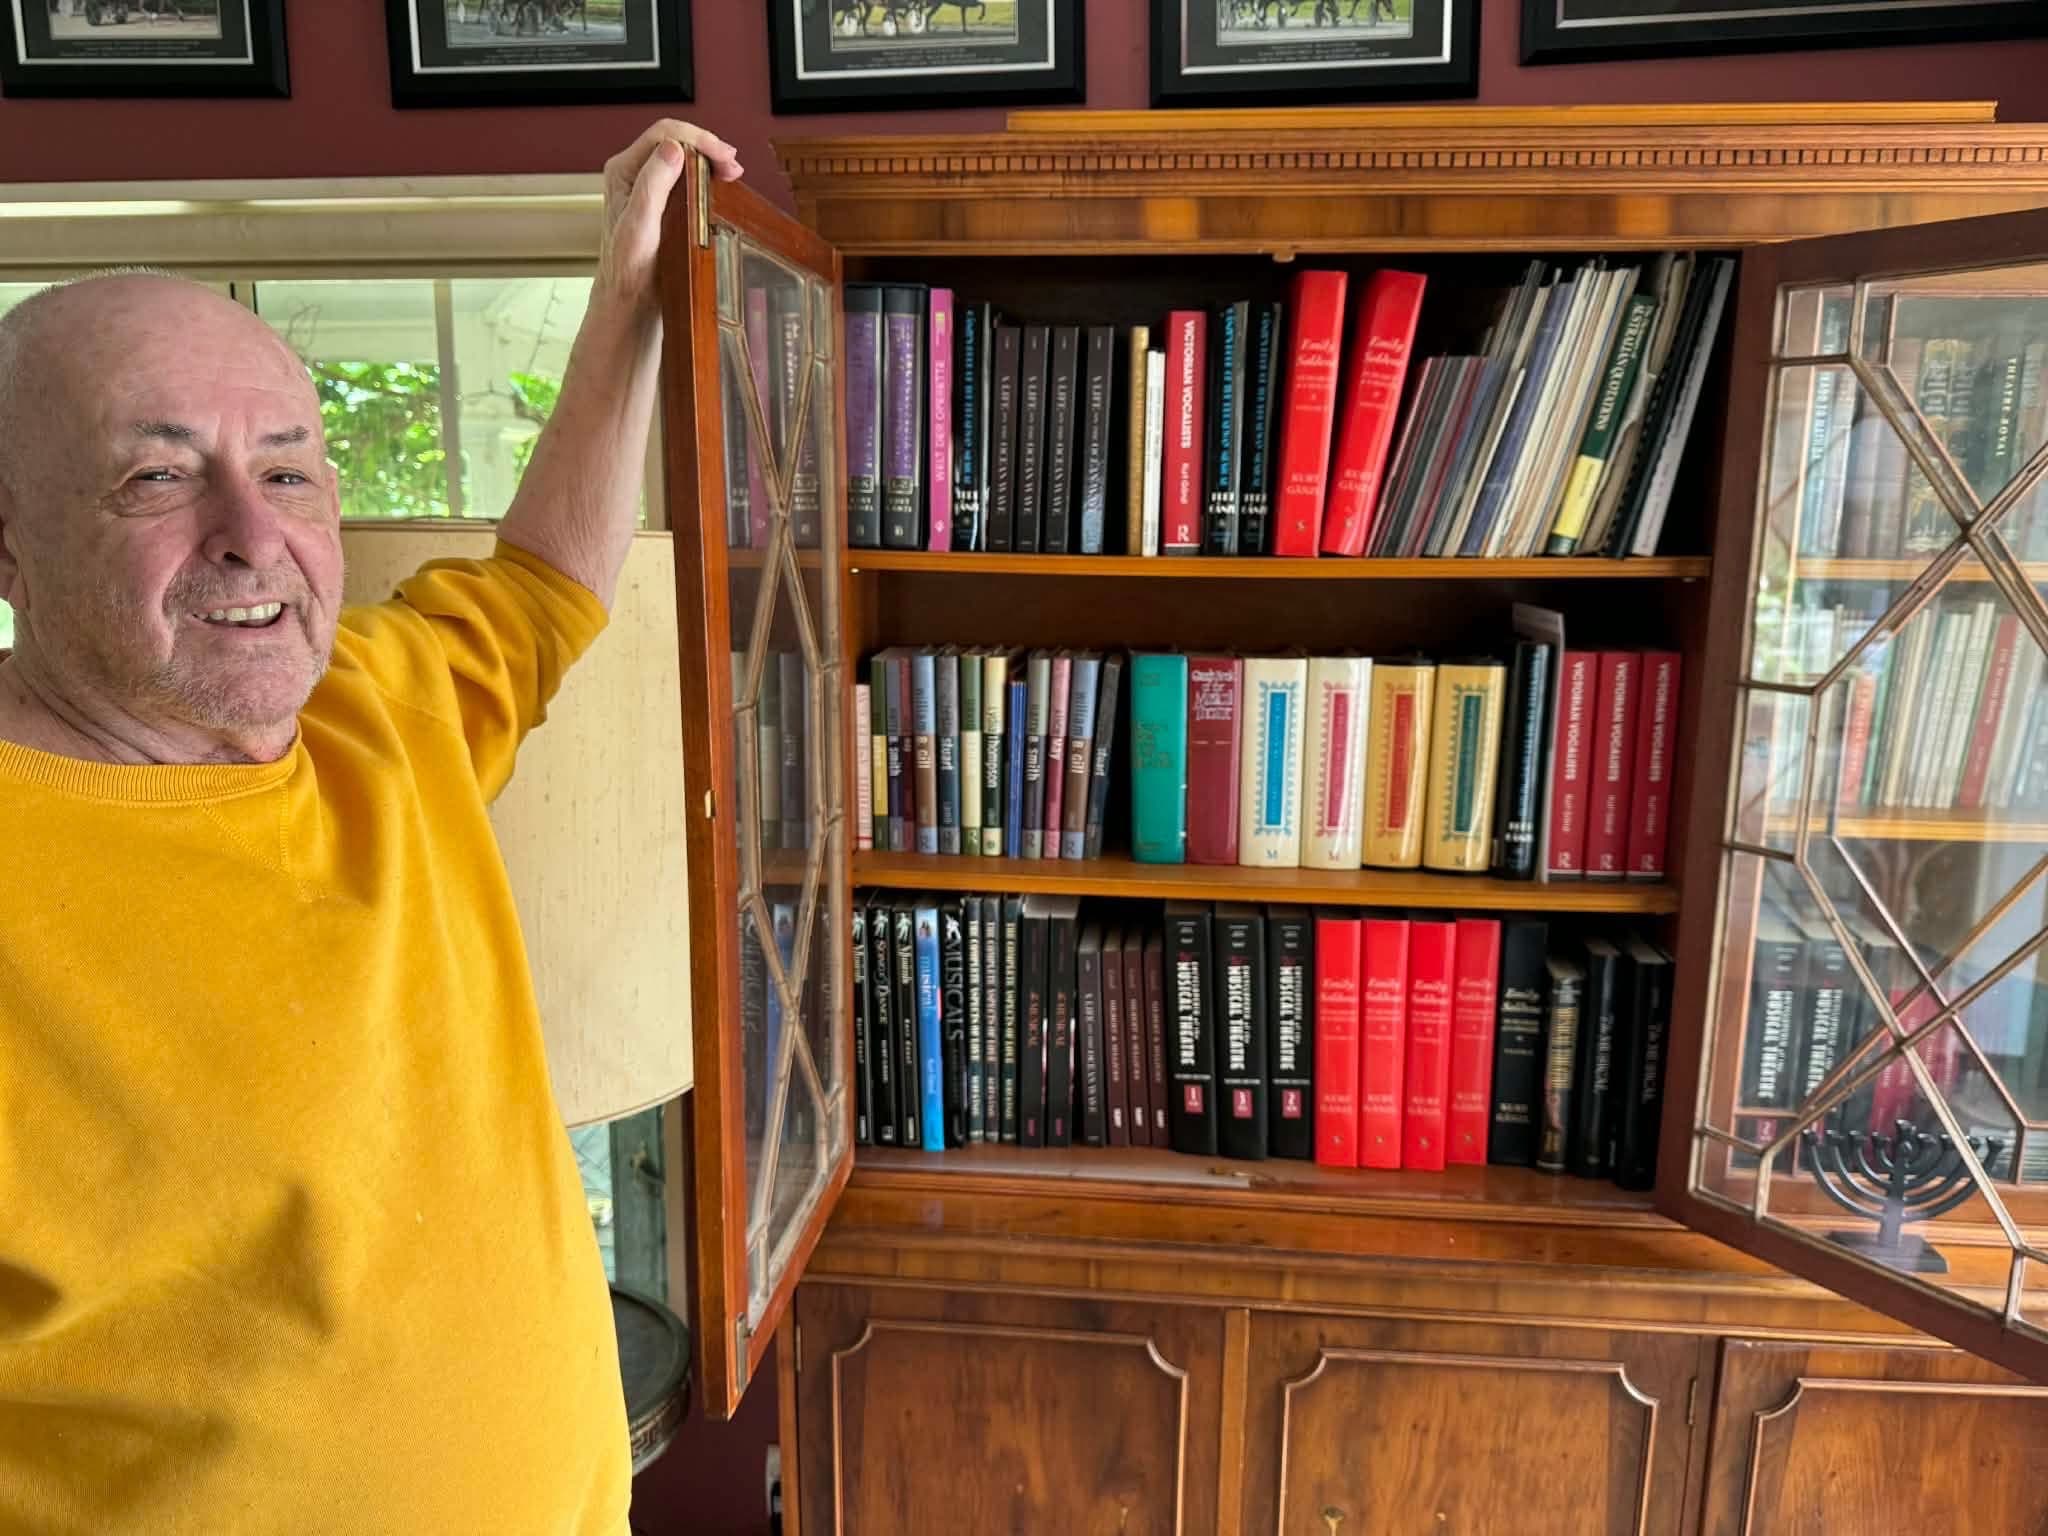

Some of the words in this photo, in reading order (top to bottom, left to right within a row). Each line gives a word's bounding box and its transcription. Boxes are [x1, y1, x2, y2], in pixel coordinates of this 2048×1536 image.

[1181, 320, 1195, 385] VICTORIAN
[1617, 303, 1647, 368] AUSTRALIAN
[1594, 366, 1625, 432] QUOTATIONS
[2001, 358, 2017, 412] THEATRE
[1180, 386, 1193, 448] VOCALISTS
[1995, 417, 2009, 457] ROYAL
[1569, 662, 1585, 720] VICTORIAN
[1612, 662, 1628, 722] VICTORIAN
[1653, 662, 1670, 722] VICTORIAN
[940, 737, 954, 770] stuart
[986, 736, 998, 788] thompson
[1027, 748, 1040, 781] smith
[1094, 747, 1106, 776] stuart
[1564, 722, 1580, 780] VOCALISTS
[1607, 723, 1623, 781] VOCALISTS
[1648, 723, 1664, 781] VOCALISTS
[920, 956, 934, 1017] musicals
[970, 939, 980, 984] COMPLETE
[1005, 941, 1015, 986] COMPLETE
[1176, 962, 1192, 1012] MUSICAL
[944, 942, 964, 1040] MUSICALS
[1228, 966, 1243, 1015] MUSICAL
[1280, 966, 1294, 1016] MUSICAL
[1763, 991, 1783, 1042] MUSICAL
[1812, 988, 1834, 1040] MUSICAL
[1180, 1014, 1194, 1066] THEATRE
[1230, 1018, 1244, 1070] THEATRE
[1280, 1020, 1294, 1070] THEATRE
[1758, 1046, 1778, 1098] THEATRE
